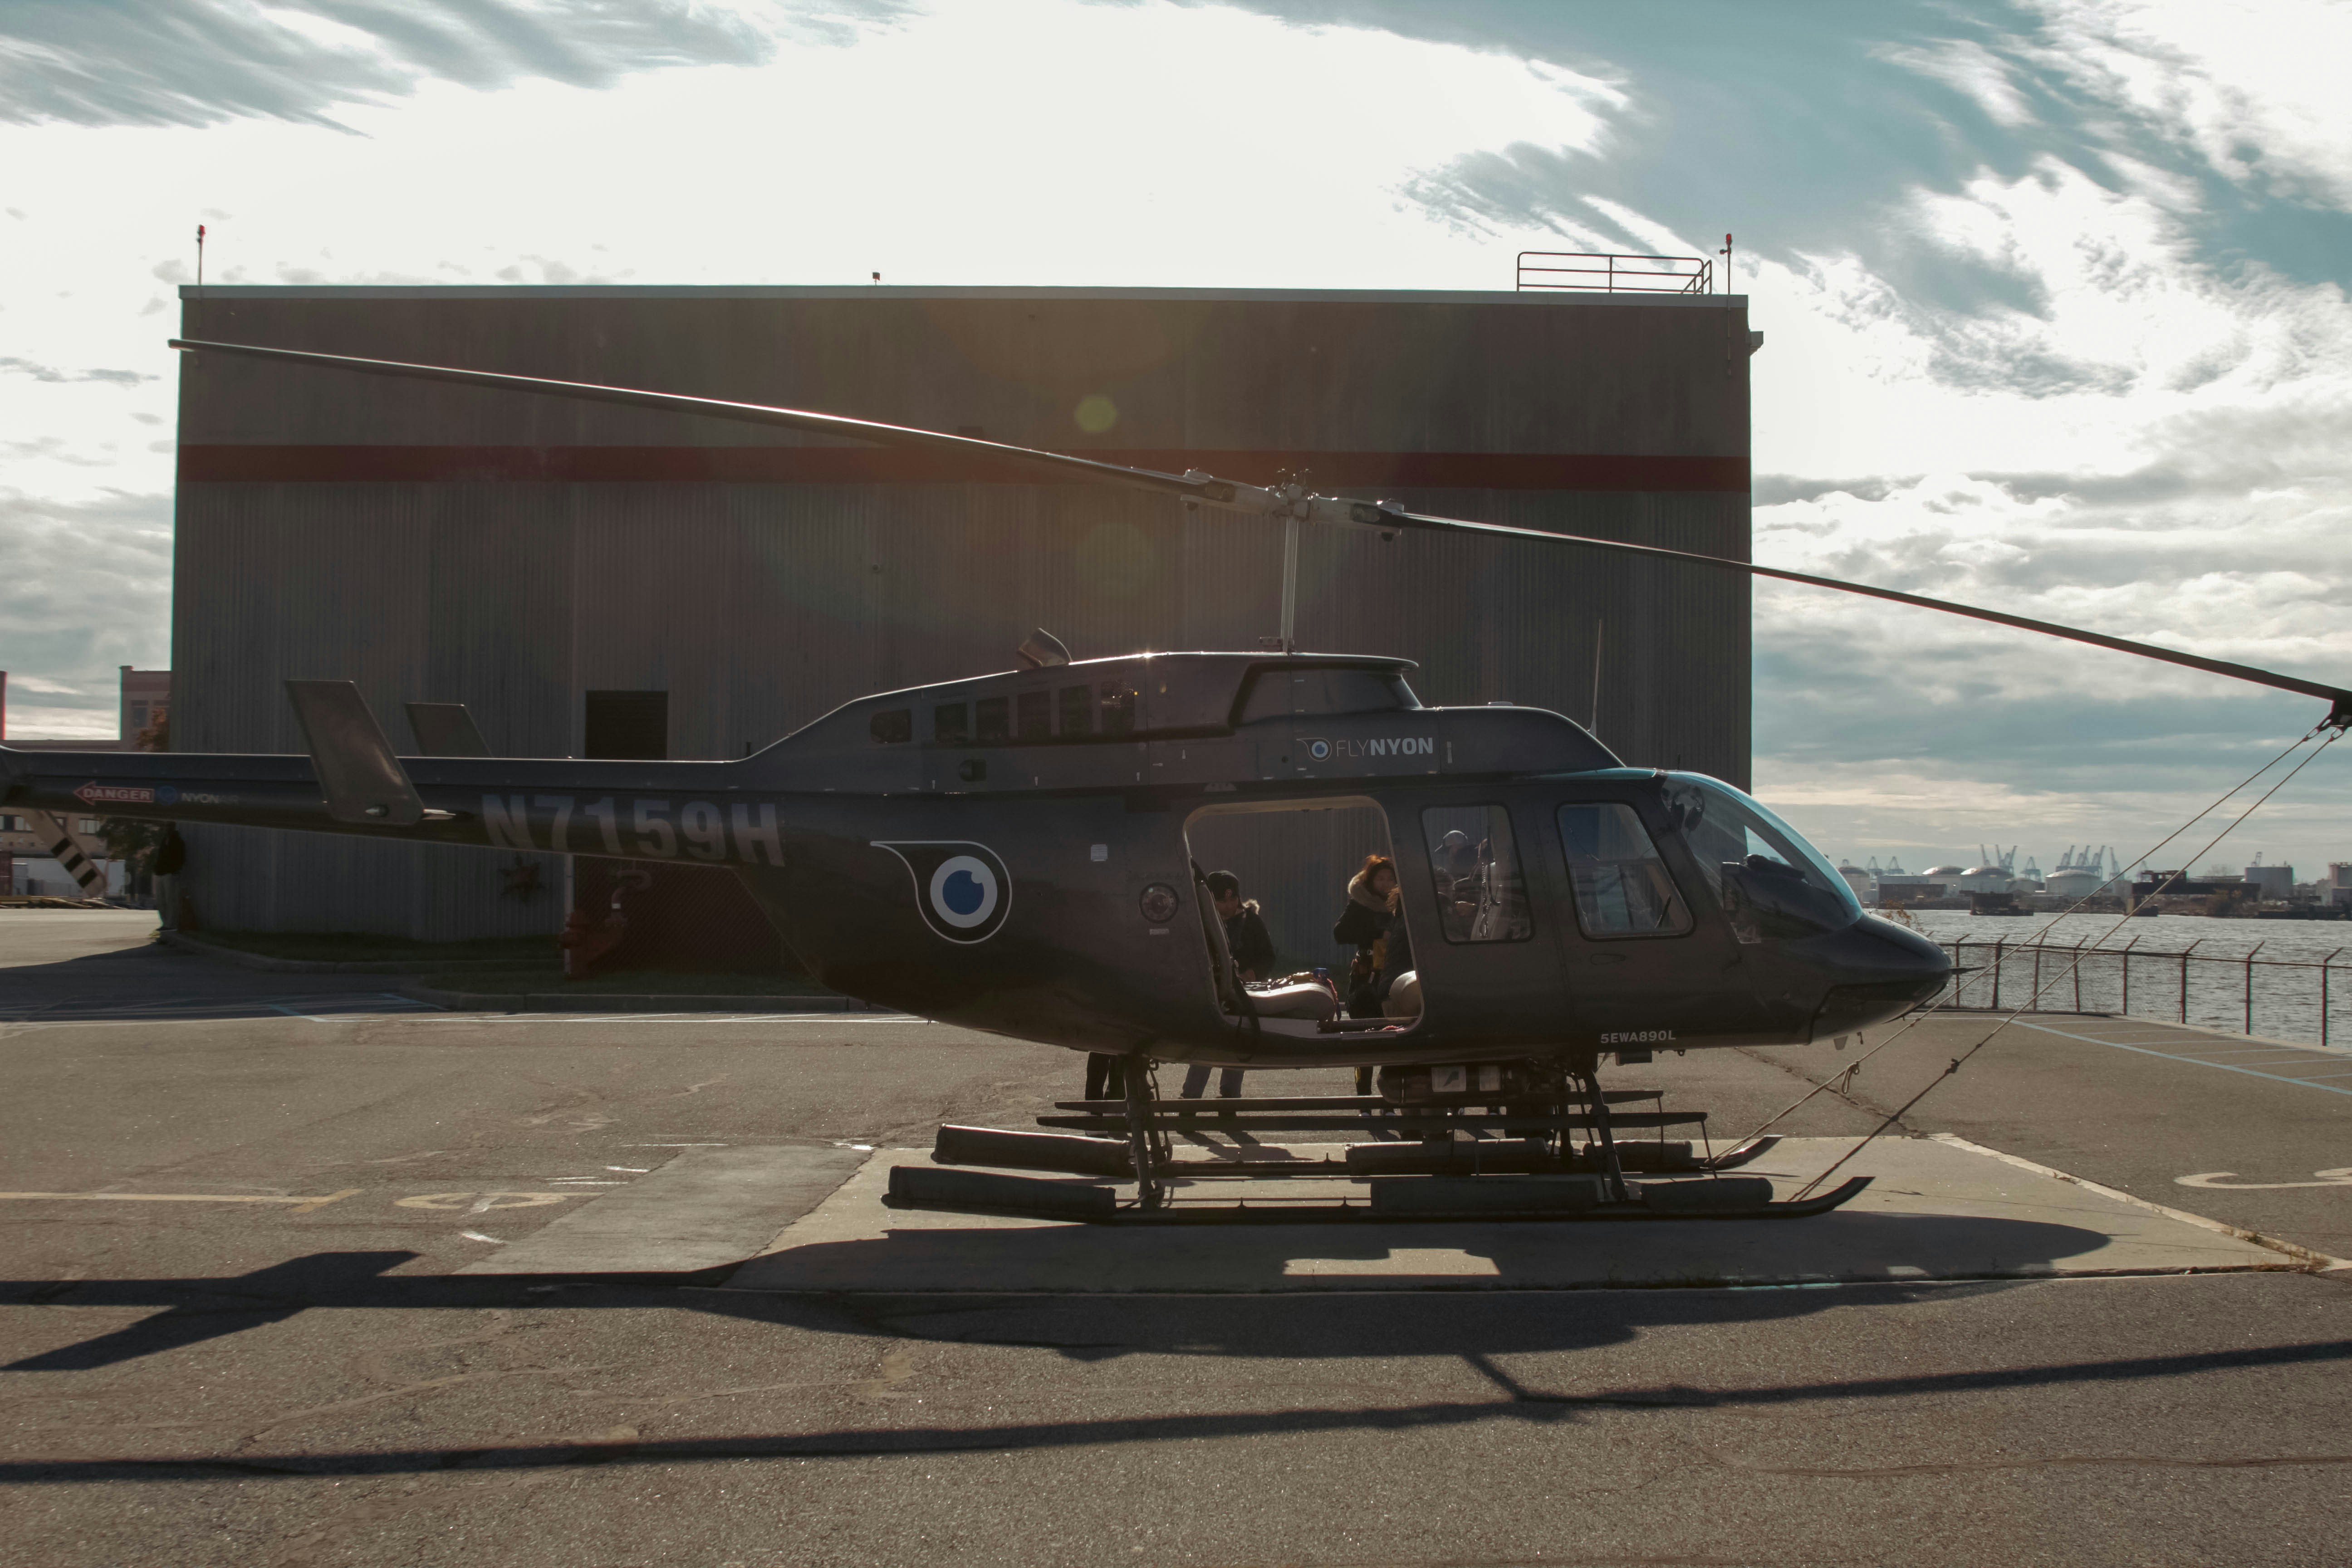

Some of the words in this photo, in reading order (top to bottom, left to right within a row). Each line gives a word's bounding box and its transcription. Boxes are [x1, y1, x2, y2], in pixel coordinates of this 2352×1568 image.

[83, 789, 151, 800] DANGER
[482, 794, 785, 867] N7159H
[1600, 1030, 1676, 1044] 5EWA890L
